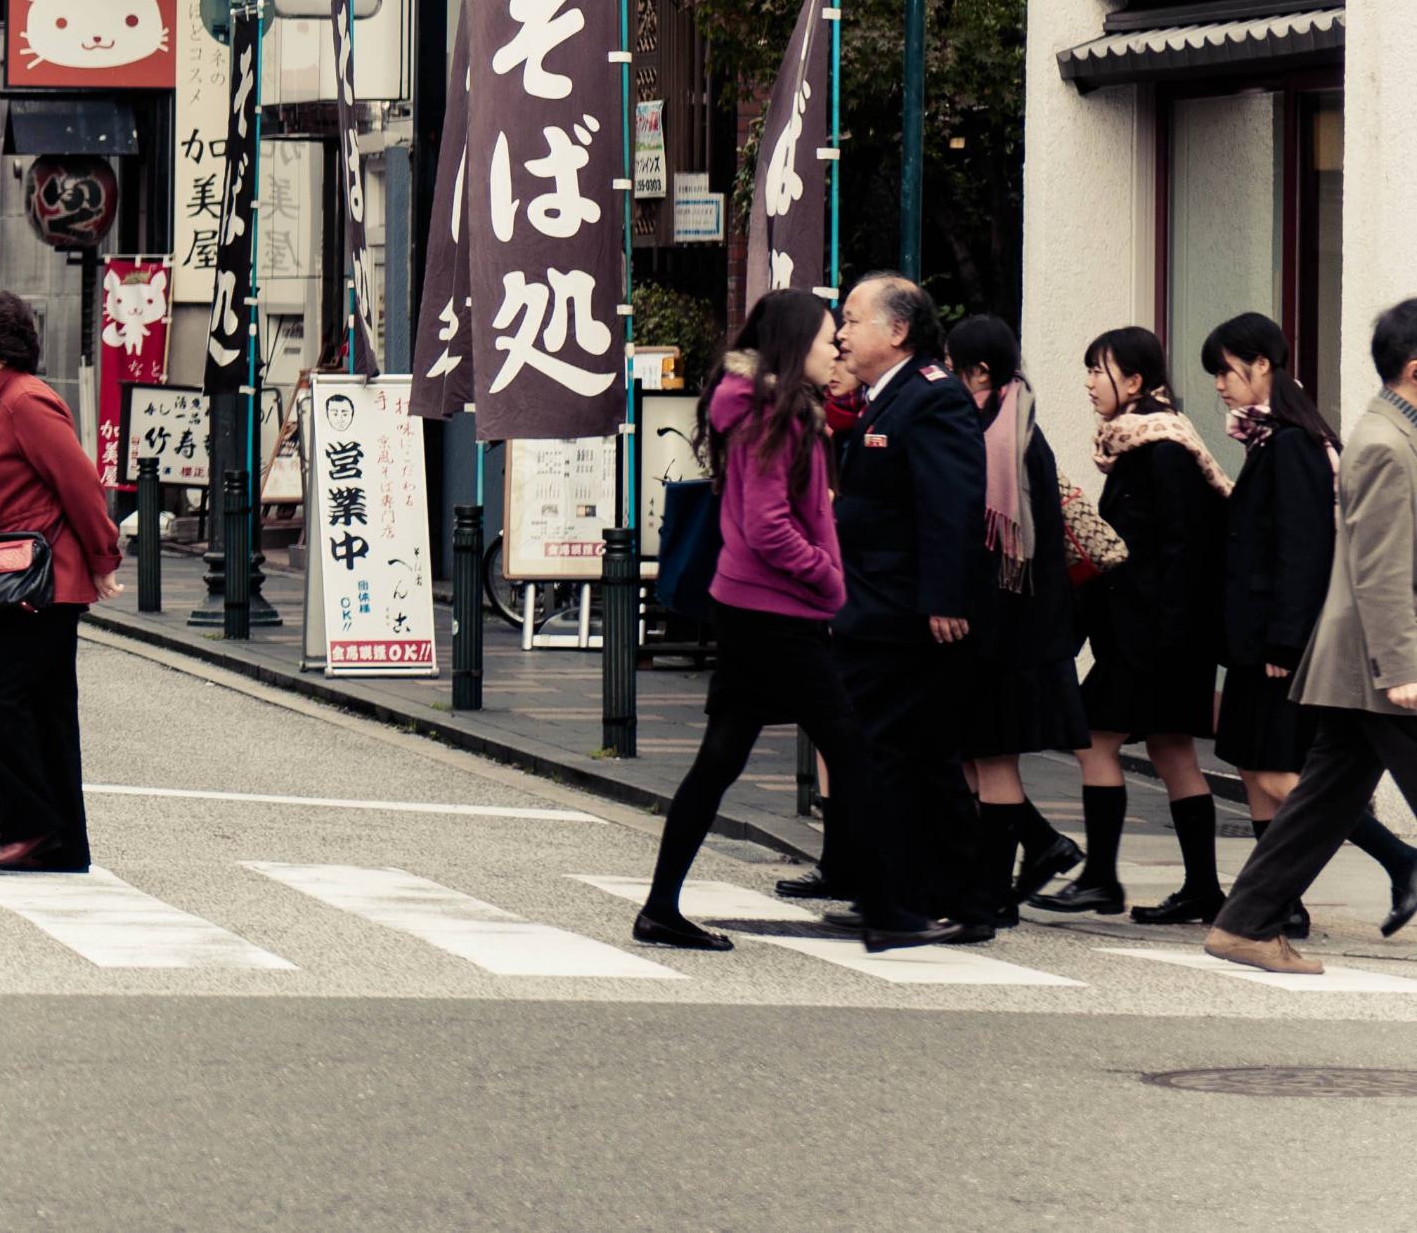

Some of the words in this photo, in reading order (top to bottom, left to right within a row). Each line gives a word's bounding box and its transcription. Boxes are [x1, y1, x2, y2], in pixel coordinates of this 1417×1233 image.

[145, 426, 211, 459] 竹寿
[325, 440, 370, 571] 営業中
